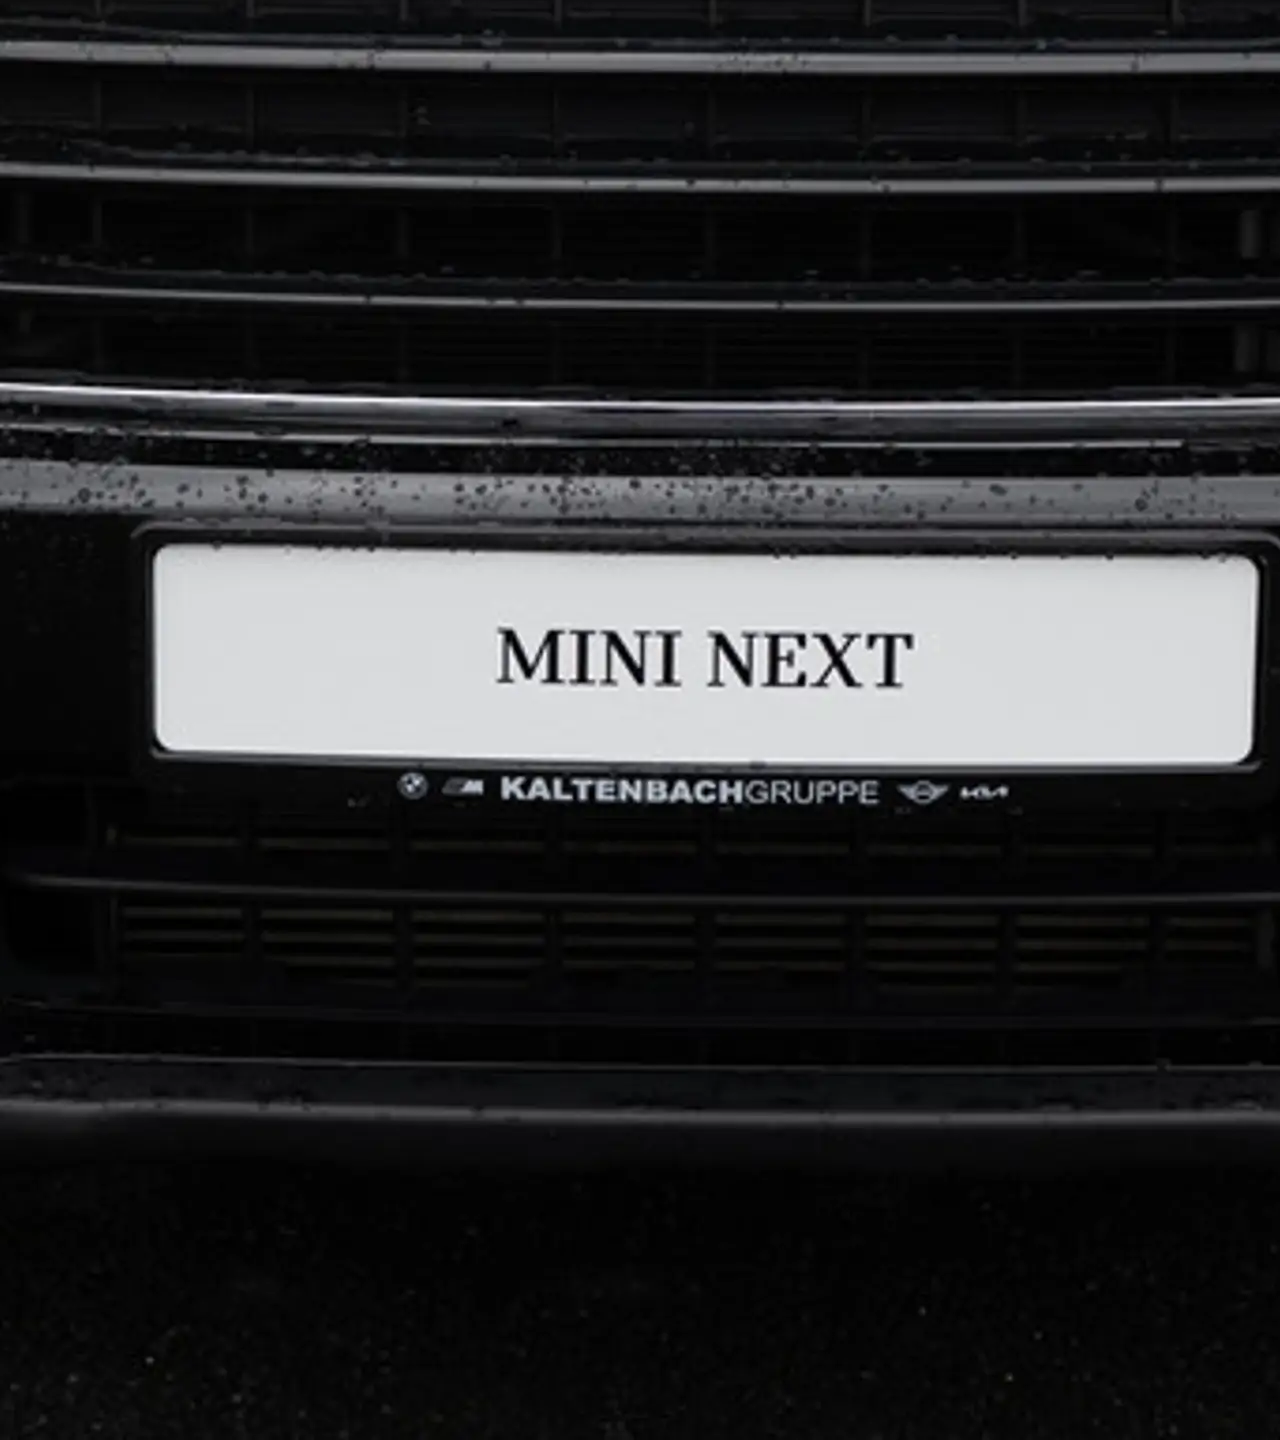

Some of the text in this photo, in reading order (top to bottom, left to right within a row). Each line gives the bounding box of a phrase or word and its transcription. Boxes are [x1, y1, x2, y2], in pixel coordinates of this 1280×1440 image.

[496, 626, 915, 688] MINI NEXT
[500, 775, 880, 805] KALTENBACHGRUPPE
